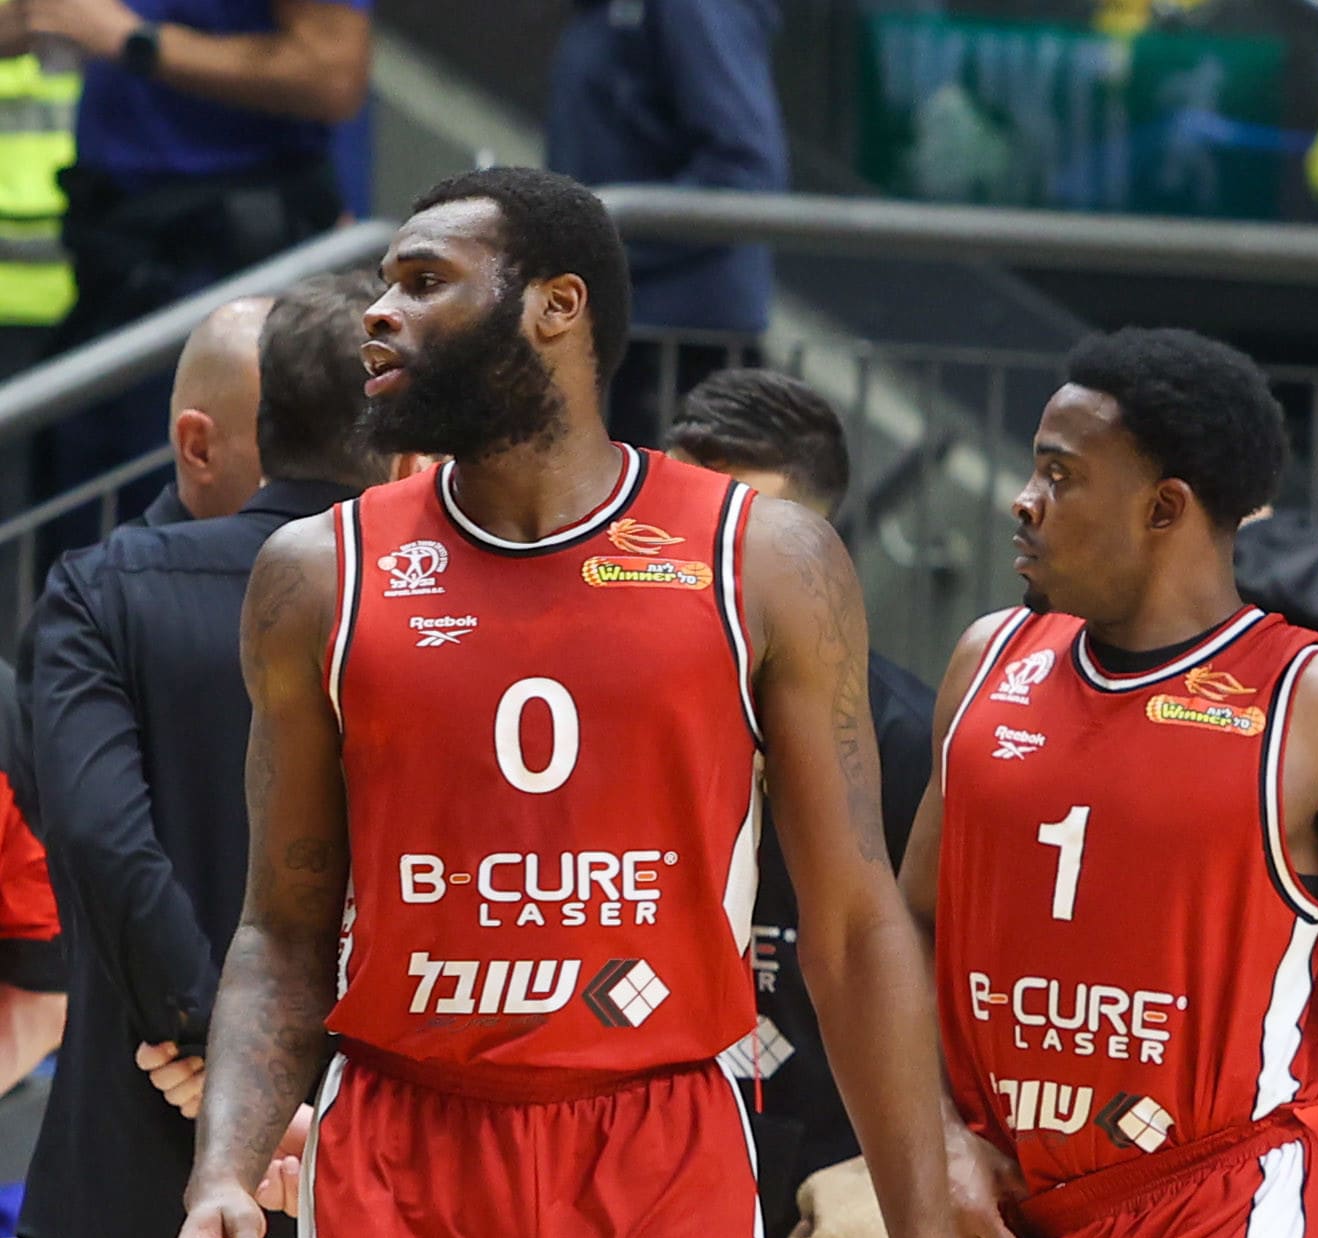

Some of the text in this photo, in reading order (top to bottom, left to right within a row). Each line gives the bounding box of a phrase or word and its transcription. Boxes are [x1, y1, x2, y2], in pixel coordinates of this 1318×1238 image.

[597, 564, 677, 582] Winner
[409, 615, 479, 630] Reebok
[494, 676, 581, 795] 0
[1037, 805, 1090, 921] 1
[479, 902, 658, 927] LASER
[406, 951, 583, 1015] שובל
[1014, 1024, 1165, 1065] LASER
